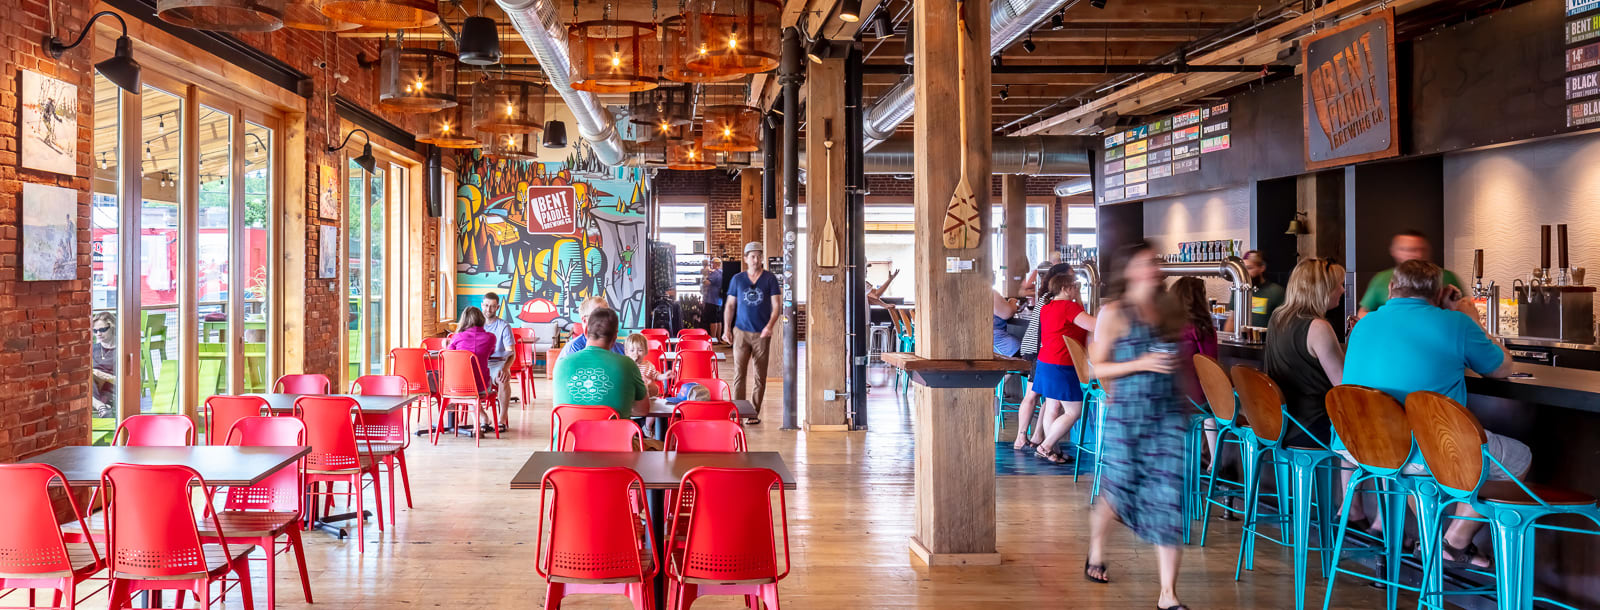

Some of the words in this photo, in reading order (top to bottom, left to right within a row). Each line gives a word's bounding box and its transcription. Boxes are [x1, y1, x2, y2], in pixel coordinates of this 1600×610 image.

[1572, 18, 1591, 35] BENT
[1593, 16, 1600, 30] H
[1320, 32, 1374, 98] BENT
[1572, 73, 1598, 90] BLACK
[1328, 75, 1382, 132] PADDLE
[1584, 101, 1600, 116] BLA
[1333, 114, 1372, 150] BREWING
[1372, 107, 1387, 125] CO.
[538, 191, 568, 212] BENT
[542, 207, 570, 223] PADDLE
